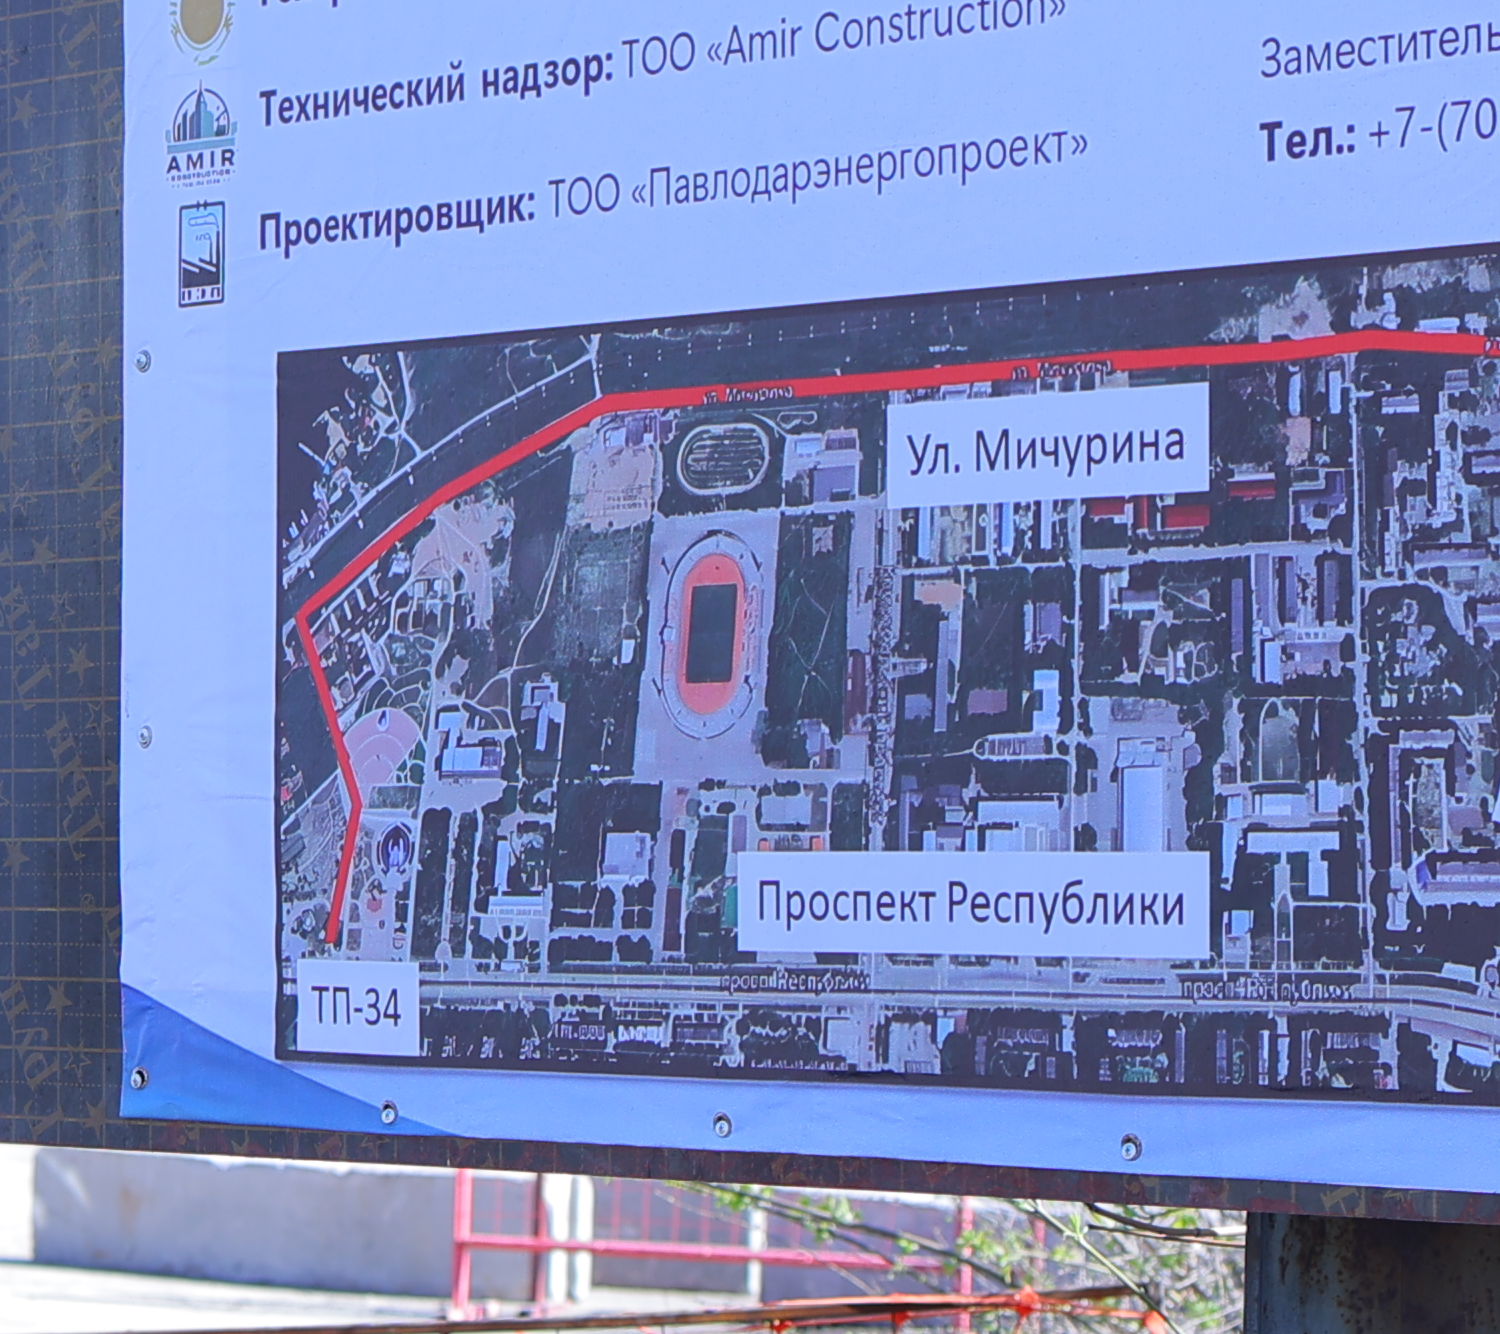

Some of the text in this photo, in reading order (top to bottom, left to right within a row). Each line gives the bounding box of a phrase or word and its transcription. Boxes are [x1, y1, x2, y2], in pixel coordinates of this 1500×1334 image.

[259, 60, 465, 126] Технический
[482, 52, 613, 100] надзор:
[621, 32, 696, 78] ТОО
[707, 17, 802, 65] «Amir
[166, 148, 235, 174] AMIR
[1259, 120, 1355, 162] Тел.:
[260, 131, 1088, 259] Проектировщик: ТОО «Павлодарэнергопроект»
[907, 428, 1184, 478] Ул. Мичурина
[759, 879, 1184, 934] Проспект Республики
[312, 986, 401, 1026] ТП-34
